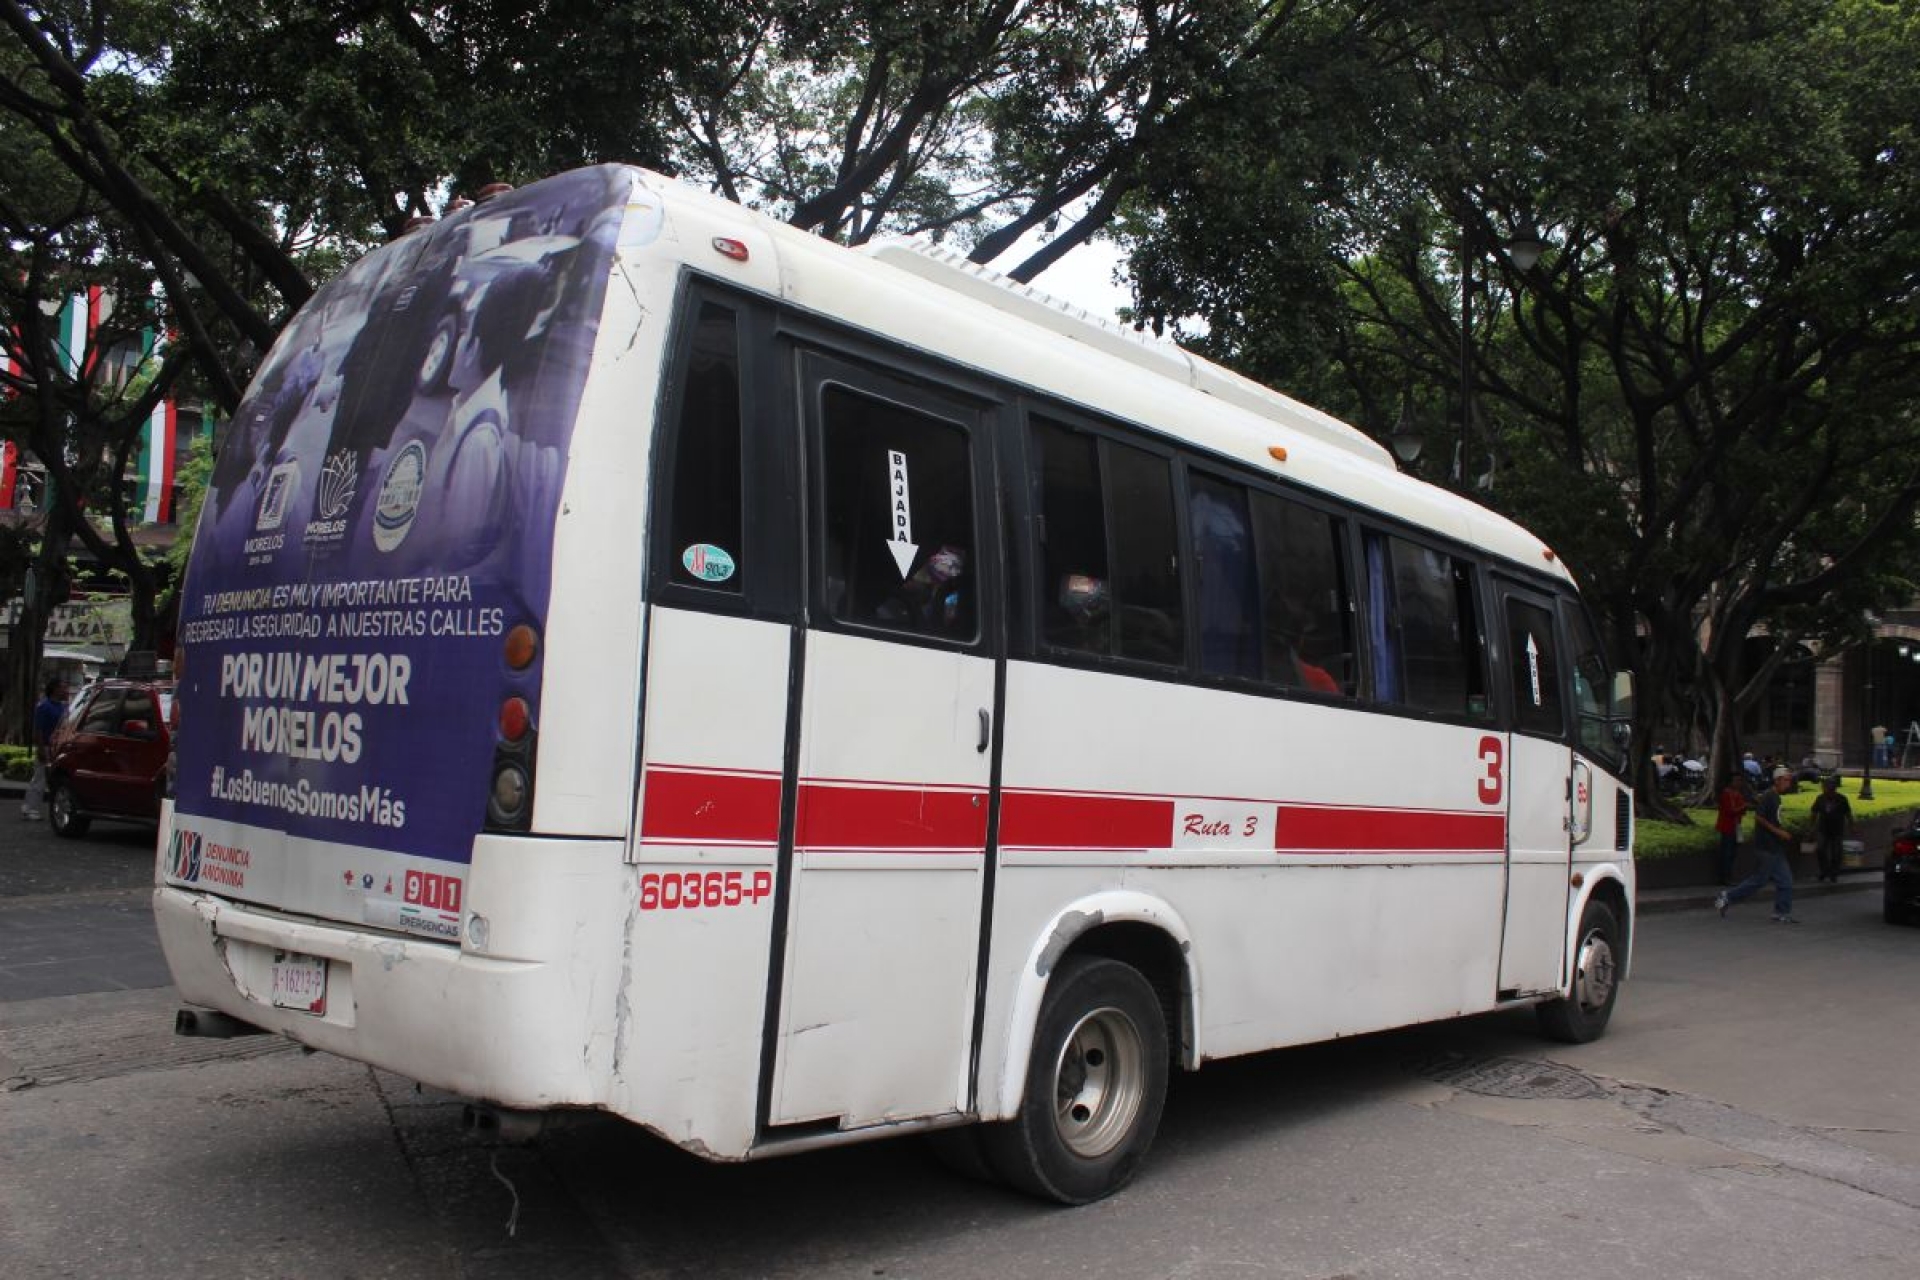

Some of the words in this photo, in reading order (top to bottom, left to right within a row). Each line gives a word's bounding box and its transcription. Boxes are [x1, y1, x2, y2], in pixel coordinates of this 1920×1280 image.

[893, 453, 908, 543] BAJADA
[243, 534, 285, 554] MORELOS
[203, 594, 216, 615] TU
[215, 587, 272, 613] DENUNCIA
[272, 584, 290, 608] ES
[290, 583, 322, 609] MUY
[321, 578, 421, 607] IMPORTANTE
[423, 575, 473, 602] PARA
[184, 617, 234, 643] REGRESAR
[235, 616, 250, 639] LA
[251, 611, 321, 638] SEGURIDAD
[325, 613, 337, 637] A
[340, 610, 427, 637] NUESTRAS
[430, 607, 504, 636] CALLES
[220, 652, 264, 697] POR
[264, 652, 300, 700] UN
[300, 652, 411, 705] MEJOR
[242, 706, 363, 764] MORELOS
[1477, 735, 1503, 805] 3
[210, 765, 406, 828] #LosBuenosSomosMás
[1183, 813, 1231, 837] Ruta
[1243, 815, 1259, 837] 3
[205, 842, 251, 869] DENUNCIA
[406, 874, 458, 908] 911
[639, 870, 772, 911] 60365-P
[399, 914, 459, 937] EMERGENCIAS
